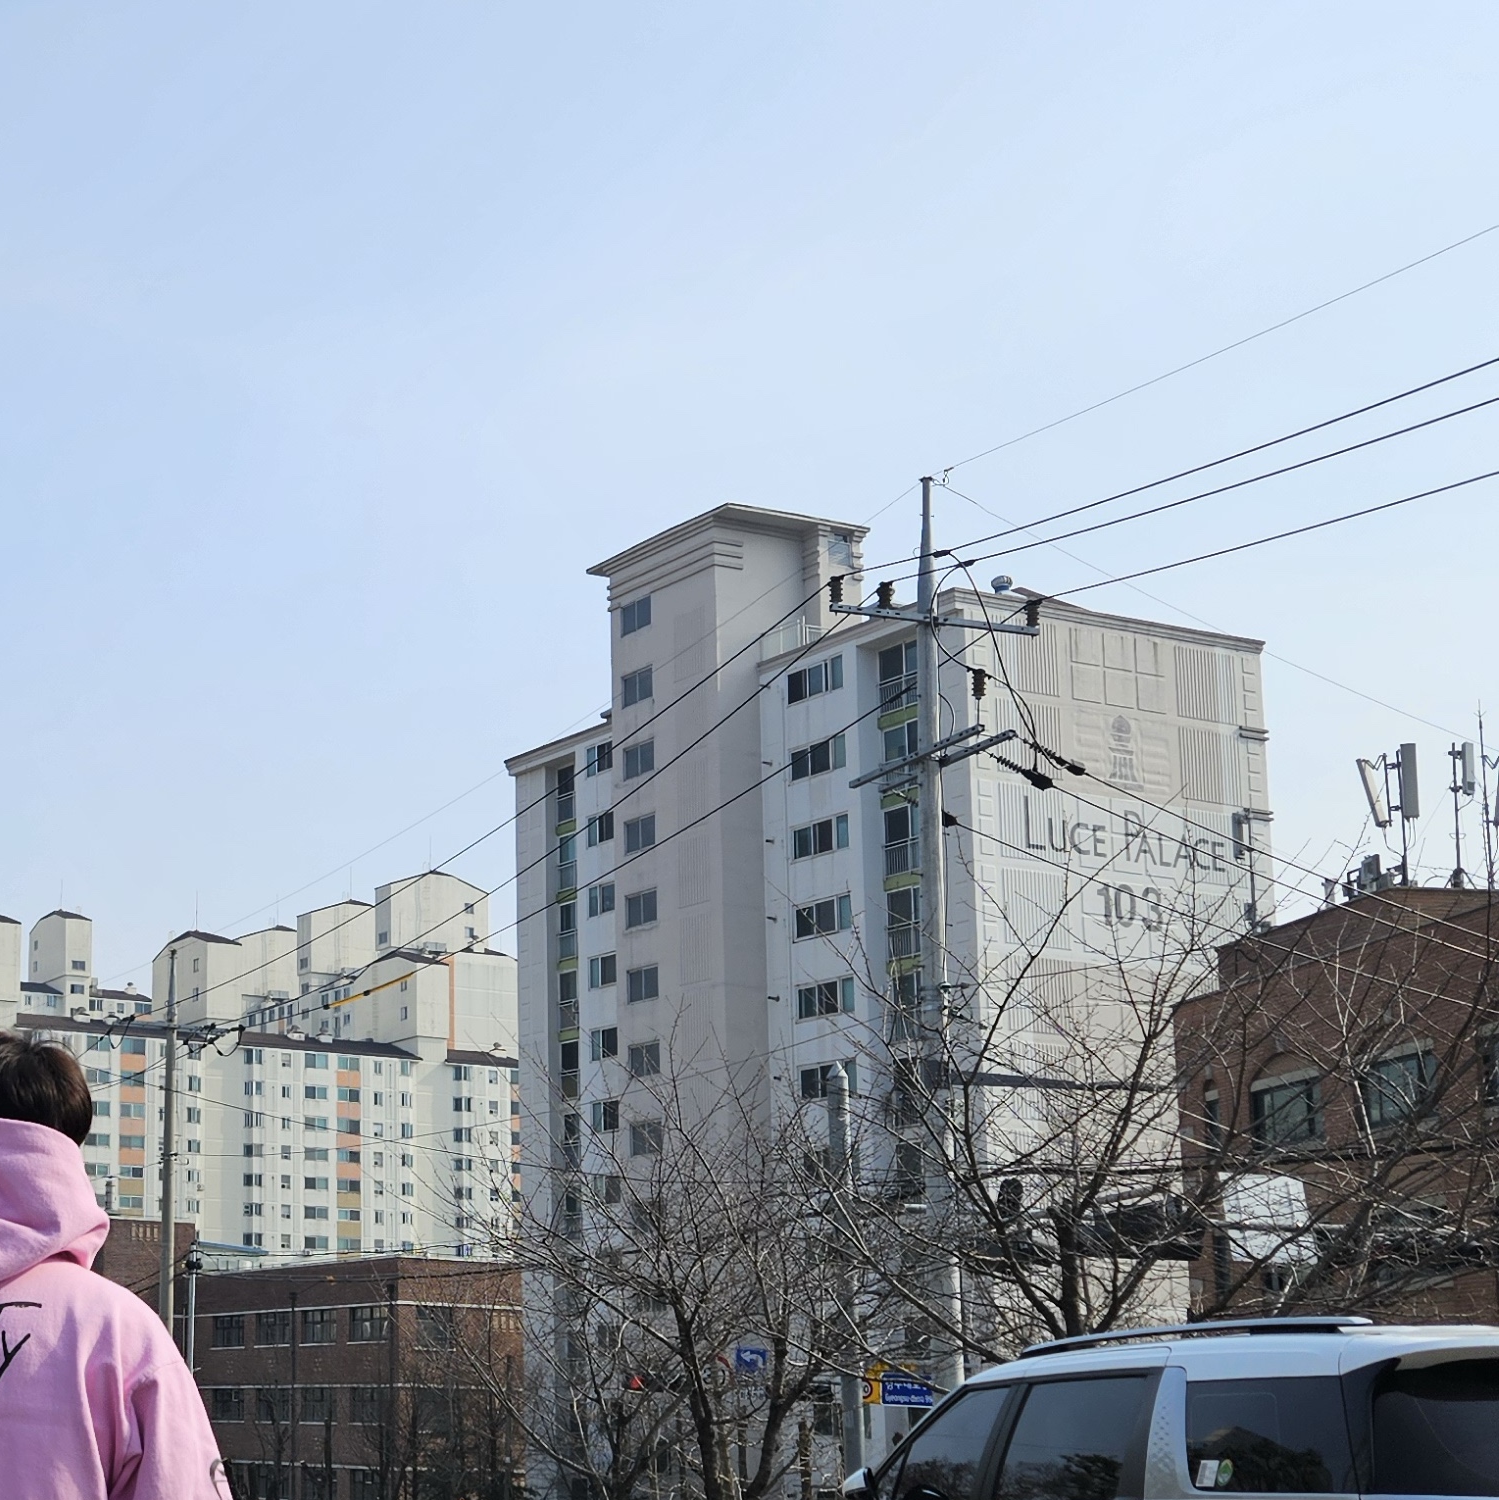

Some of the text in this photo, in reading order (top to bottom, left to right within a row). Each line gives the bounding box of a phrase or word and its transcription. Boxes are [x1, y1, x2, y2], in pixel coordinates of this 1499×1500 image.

[1023, 795, 1227, 873] LUCE PALACE
[1096, 883, 1164, 933] 103
